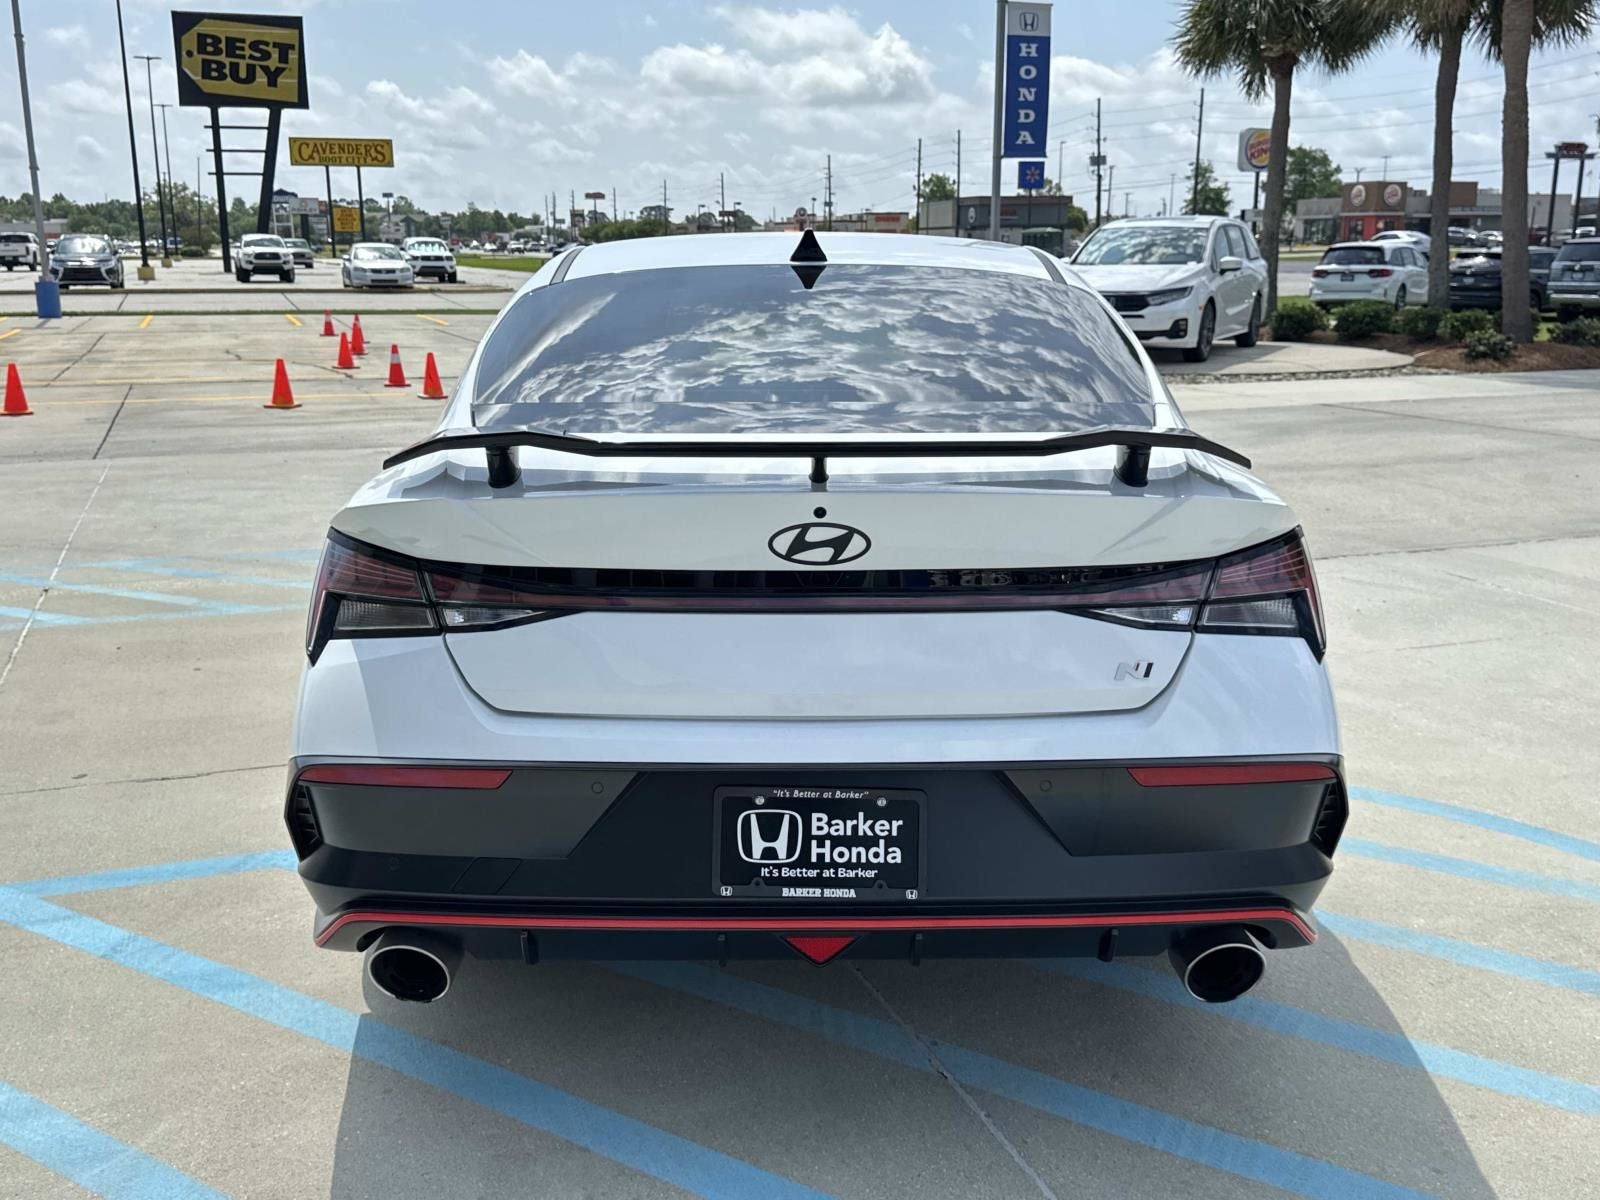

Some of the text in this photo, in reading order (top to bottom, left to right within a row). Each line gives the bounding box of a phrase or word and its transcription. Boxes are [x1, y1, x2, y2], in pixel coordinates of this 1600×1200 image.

[196, 32, 295, 65] BEST
[201, 58, 288, 88] BUY
[1015, 43, 1038, 144] HONDA
[298, 142, 386, 163] CAVENDER'S
[793, 789, 820, 799] Better
[823, 791, 832, 799] at
[811, 811, 903, 837] Barker
[811, 839, 902, 864] Honda
[761, 866, 878, 879] It's Better at Barker
[782, 887, 856, 898] BARKER HONDA
